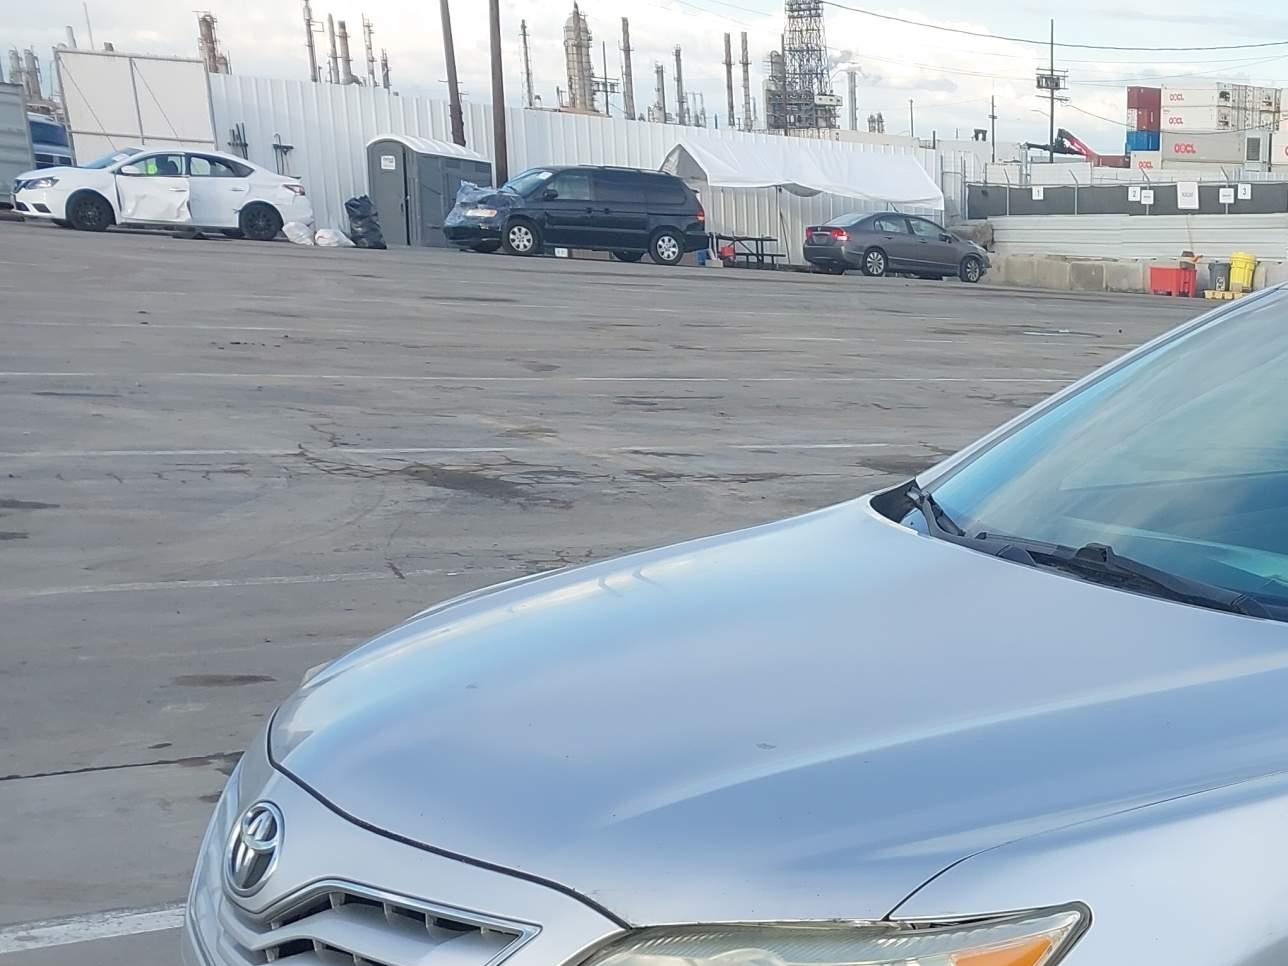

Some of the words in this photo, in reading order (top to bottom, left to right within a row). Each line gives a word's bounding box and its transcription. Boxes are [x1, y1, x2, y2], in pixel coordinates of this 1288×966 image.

[1169, 93, 1184, 101] OOCL
[1169, 117, 1184, 125] OOCL
[1174, 143, 1196, 154] OOCL
[1138, 161, 1153, 169] OOCL
